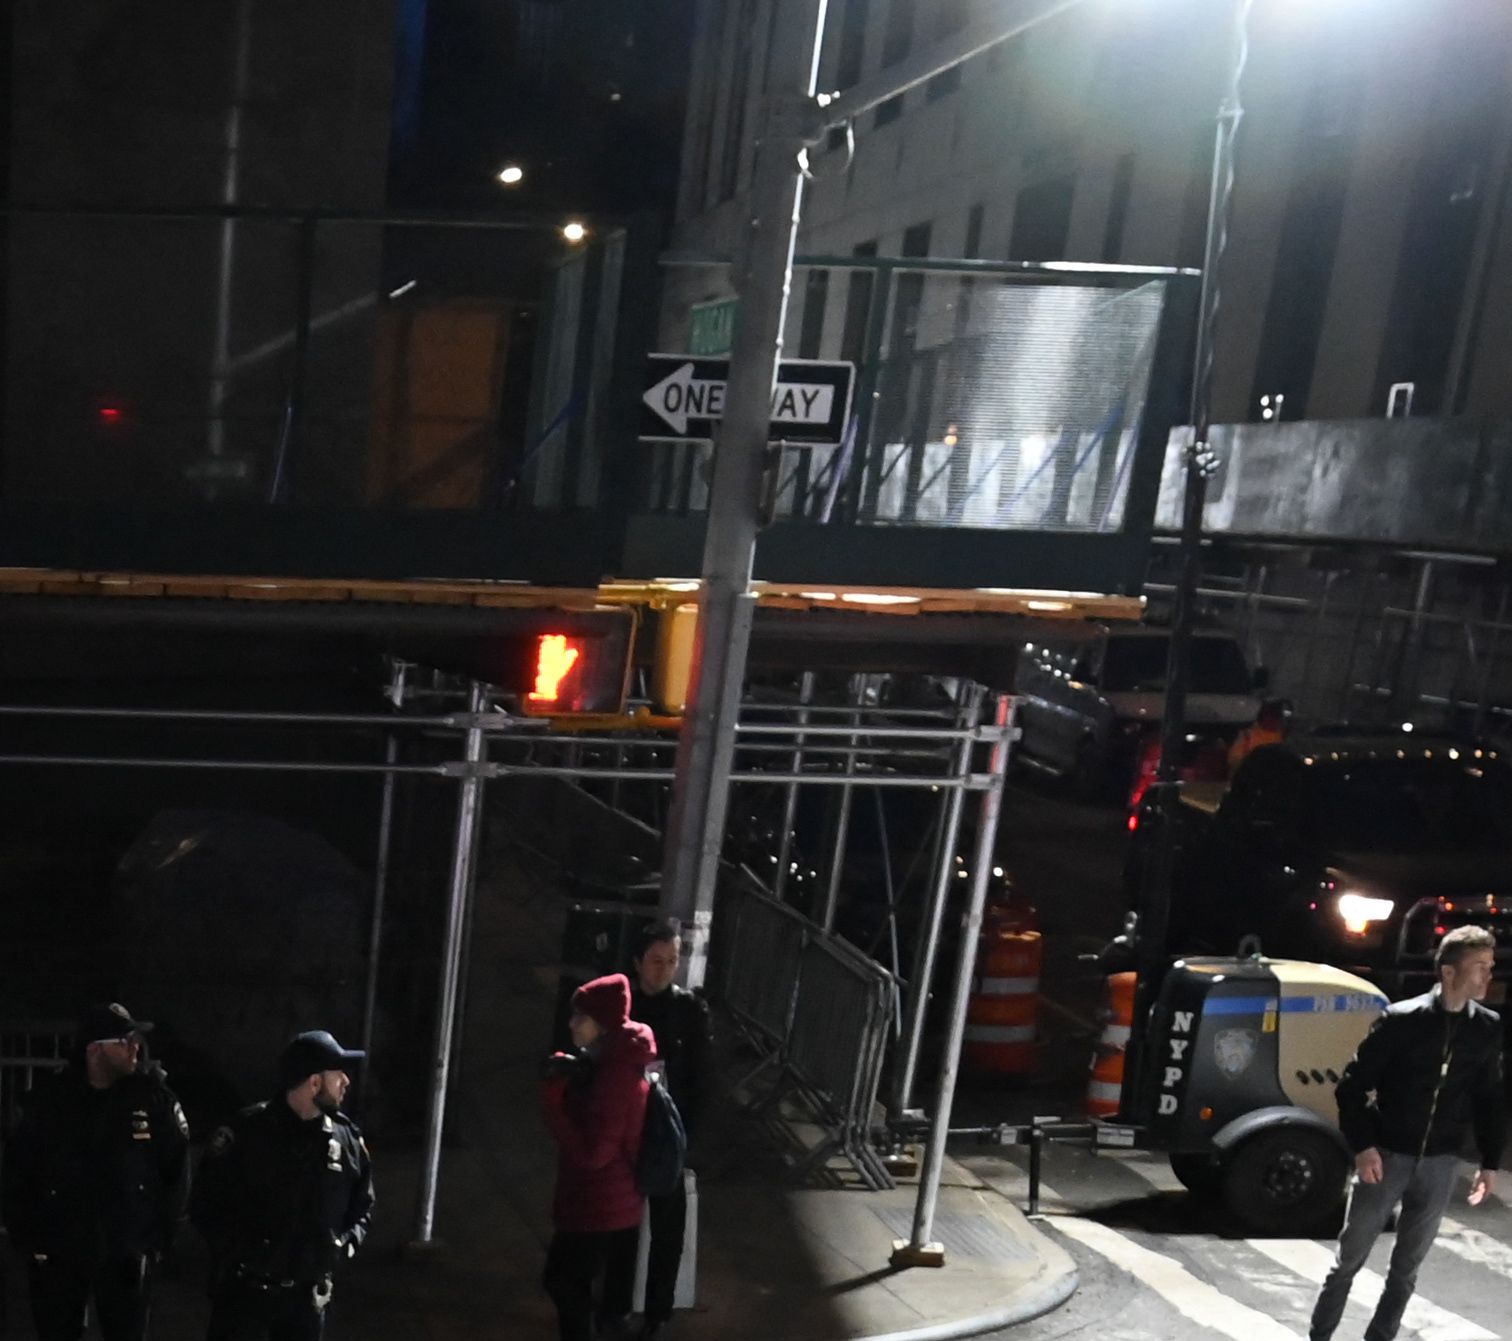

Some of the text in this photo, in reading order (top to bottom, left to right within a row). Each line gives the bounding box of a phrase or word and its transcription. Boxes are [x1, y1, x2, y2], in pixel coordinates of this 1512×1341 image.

[664, 383, 820, 418] ONE AY
[1158, 1010, 1194, 1115] NYPD
